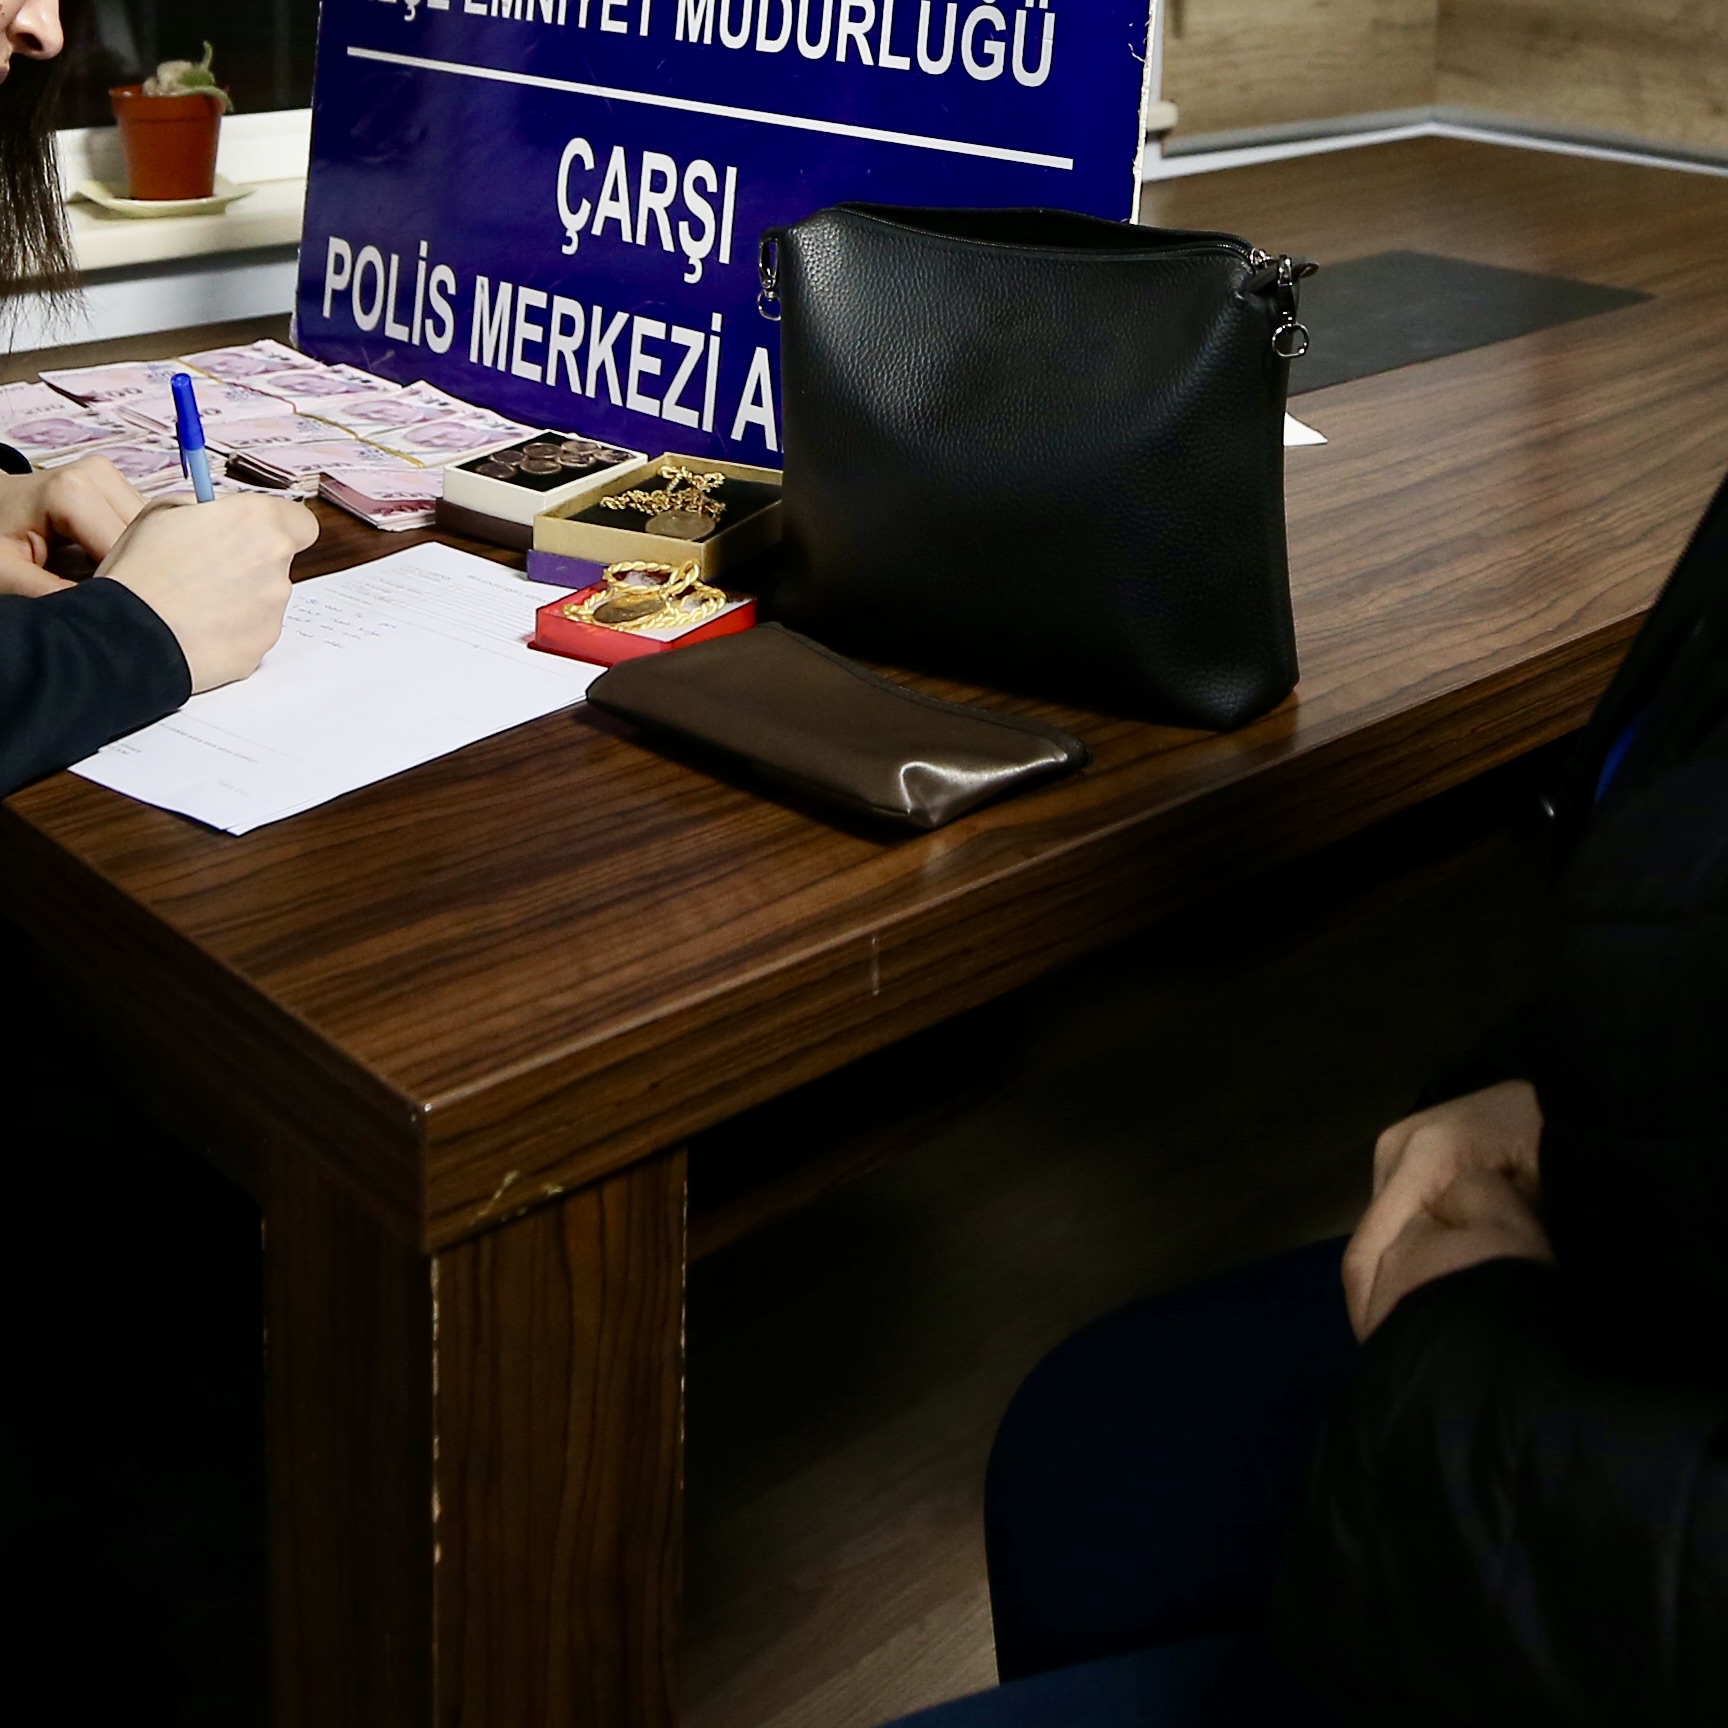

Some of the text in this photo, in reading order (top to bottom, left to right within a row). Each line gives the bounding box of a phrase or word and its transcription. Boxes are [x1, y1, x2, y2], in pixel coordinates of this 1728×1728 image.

[557, 137, 738, 285] ÇARŞI
[322, 236, 784, 454] POLİS MERKEZİ A
